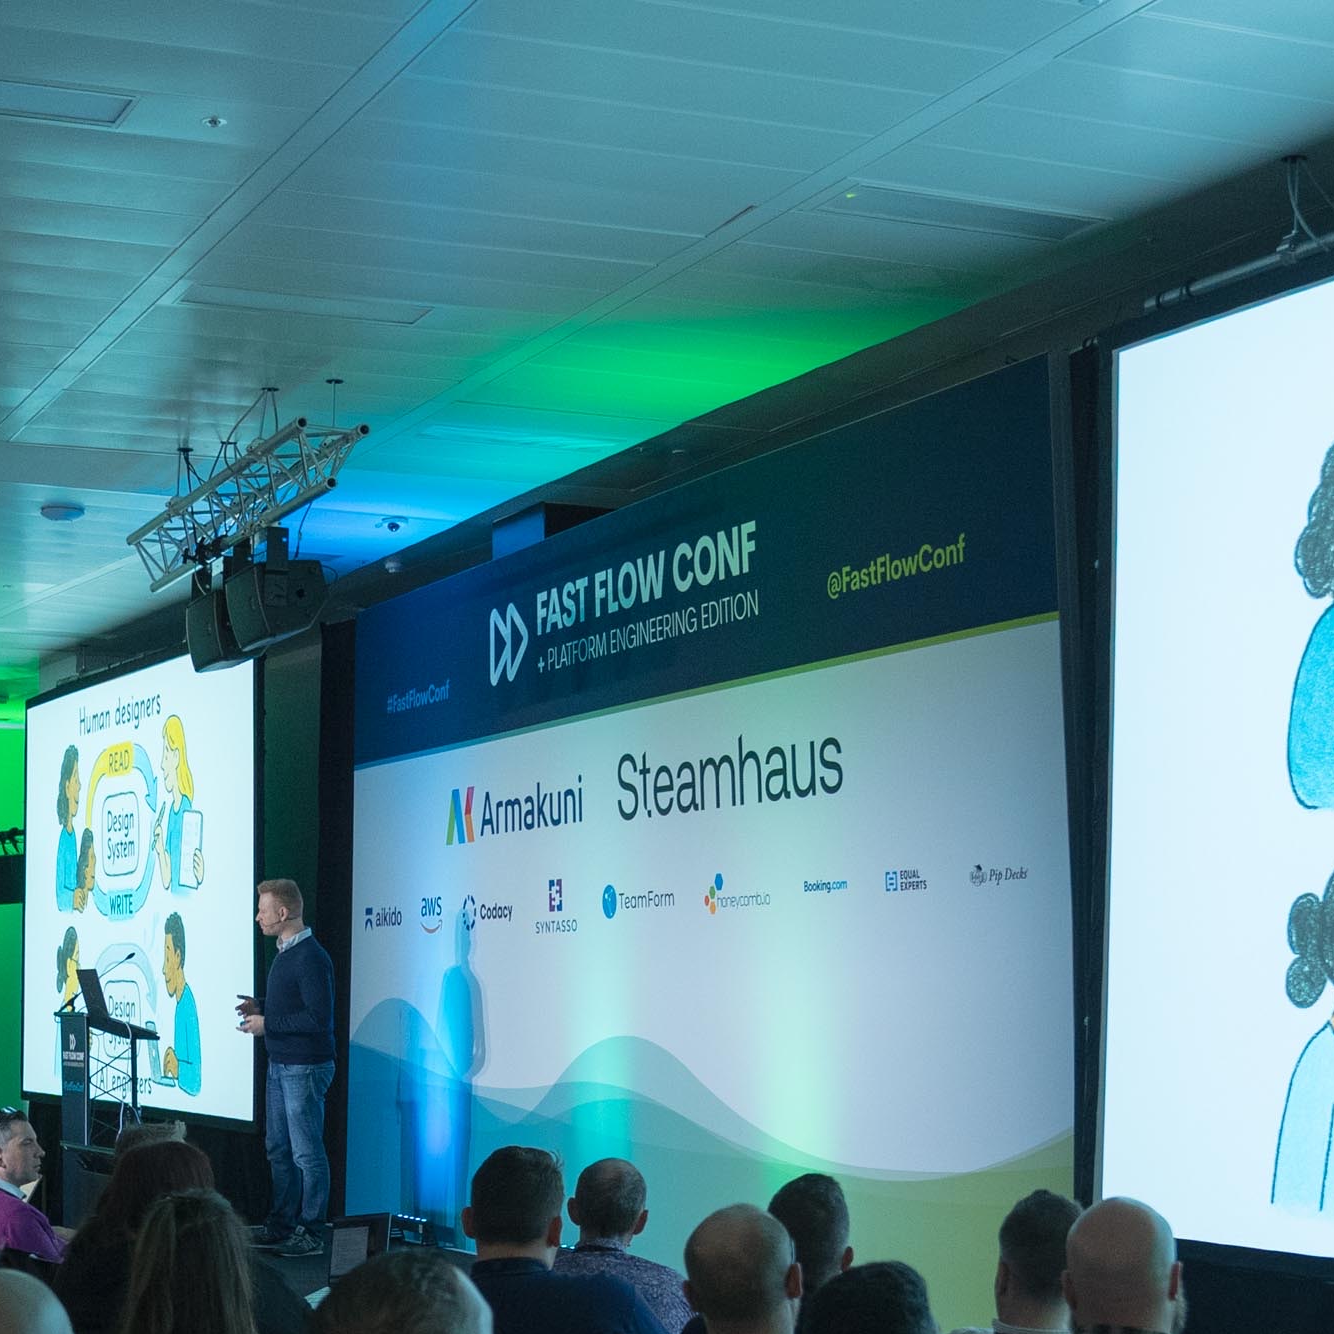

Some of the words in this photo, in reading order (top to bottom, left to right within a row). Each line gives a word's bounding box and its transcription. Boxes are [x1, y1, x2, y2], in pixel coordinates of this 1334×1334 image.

[536, 576, 589, 636] FAST
[594, 550, 665, 618] FLOW
[672, 519, 756, 593] CONF
[827, 532, 966, 599] @FastFlowConf
[547, 632, 607, 671] PLATFORM
[610, 606, 698, 654] ENGINEERING
[701, 589, 759, 630] EDITION
[387, 678, 450, 714] #FastFlowConf
[79, 705, 110, 736] Human
[115, 693, 161, 729] designers
[108, 749, 130, 774] READ
[617, 733, 844, 821] Steamhaus
[480, 775, 583, 837] Armakuni
[107, 808, 135, 838] Design
[107, 837, 135, 864] System
[803, 879, 848, 894] Booking.com
[899, 869, 921, 881] EQUAL
[899, 879, 928, 892] EXPERTS
[988, 868, 1003, 886] Pip
[109, 893, 133, 915] WRITE
[421, 895, 442, 917] aws
[479, 902, 513, 922] Codacy
[618, 890, 675, 910] TeamForm
[375, 906, 402, 928] aikido
[535, 919, 578, 934] SYNTASSO
[108, 995, 136, 1023] Design
